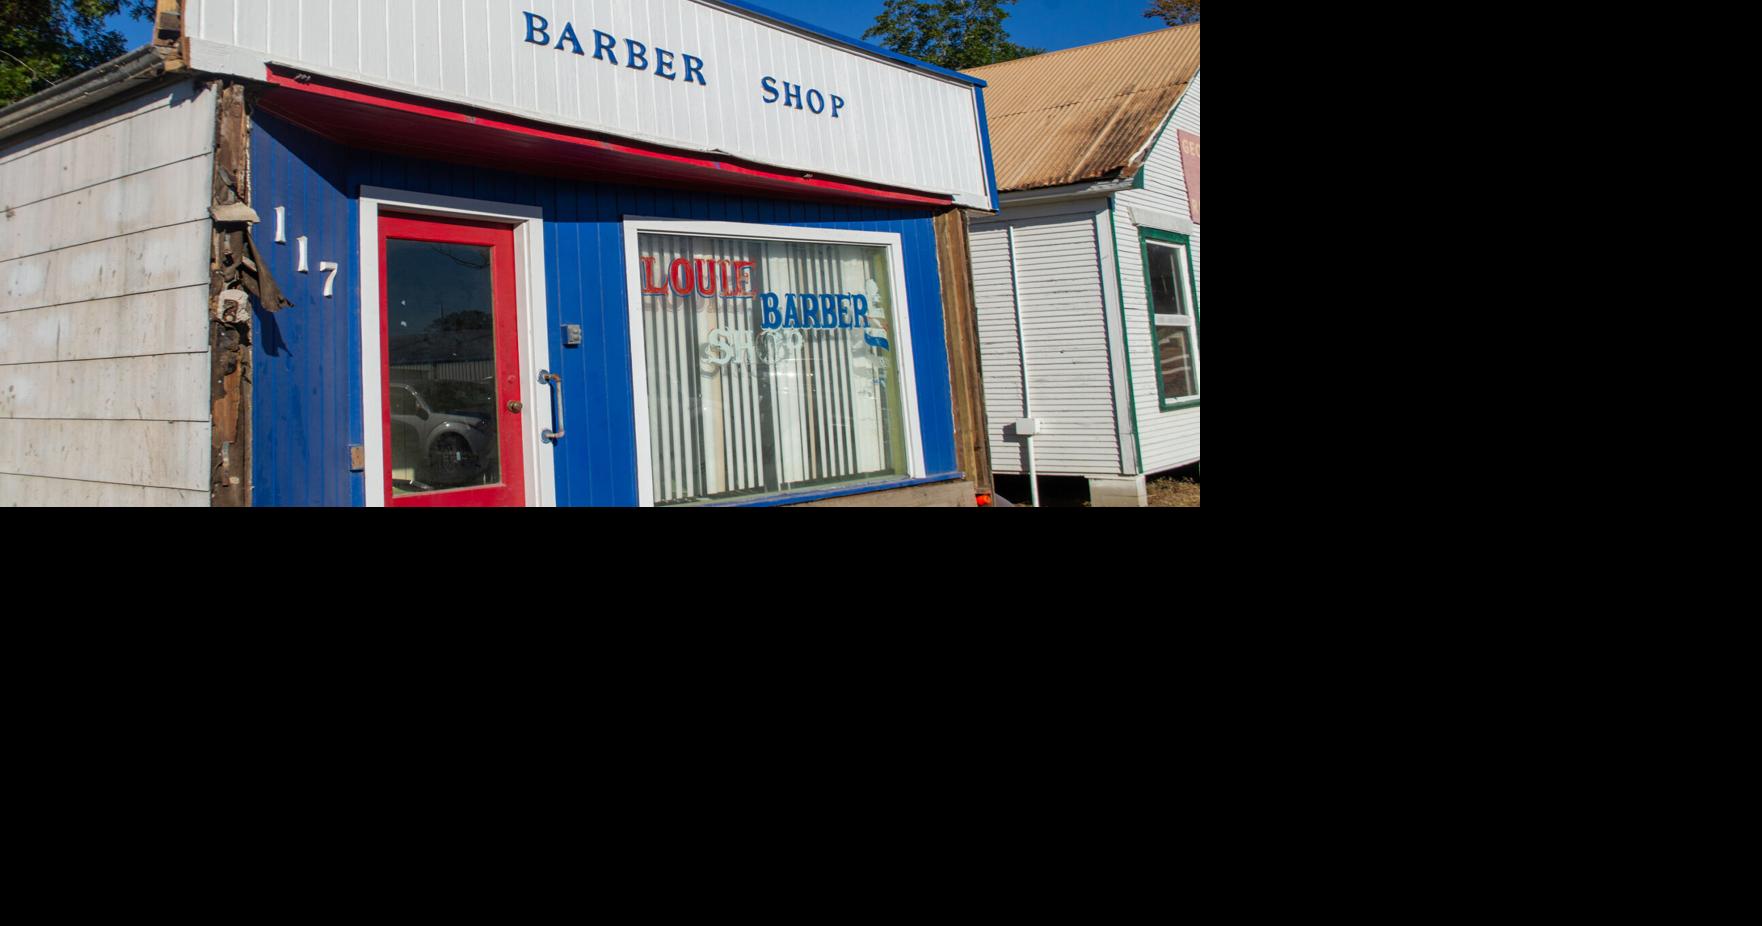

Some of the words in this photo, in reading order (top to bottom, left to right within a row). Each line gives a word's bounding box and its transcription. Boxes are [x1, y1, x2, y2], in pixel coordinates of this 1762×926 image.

[523, 11, 706, 86] BARBER
[761, 76, 845, 118] SHOP
[273, 205, 339, 297] 117
[640, 256, 757, 299] LOUIE
[760, 292, 869, 330] BARBER
[704, 327, 803, 365] SHOP
